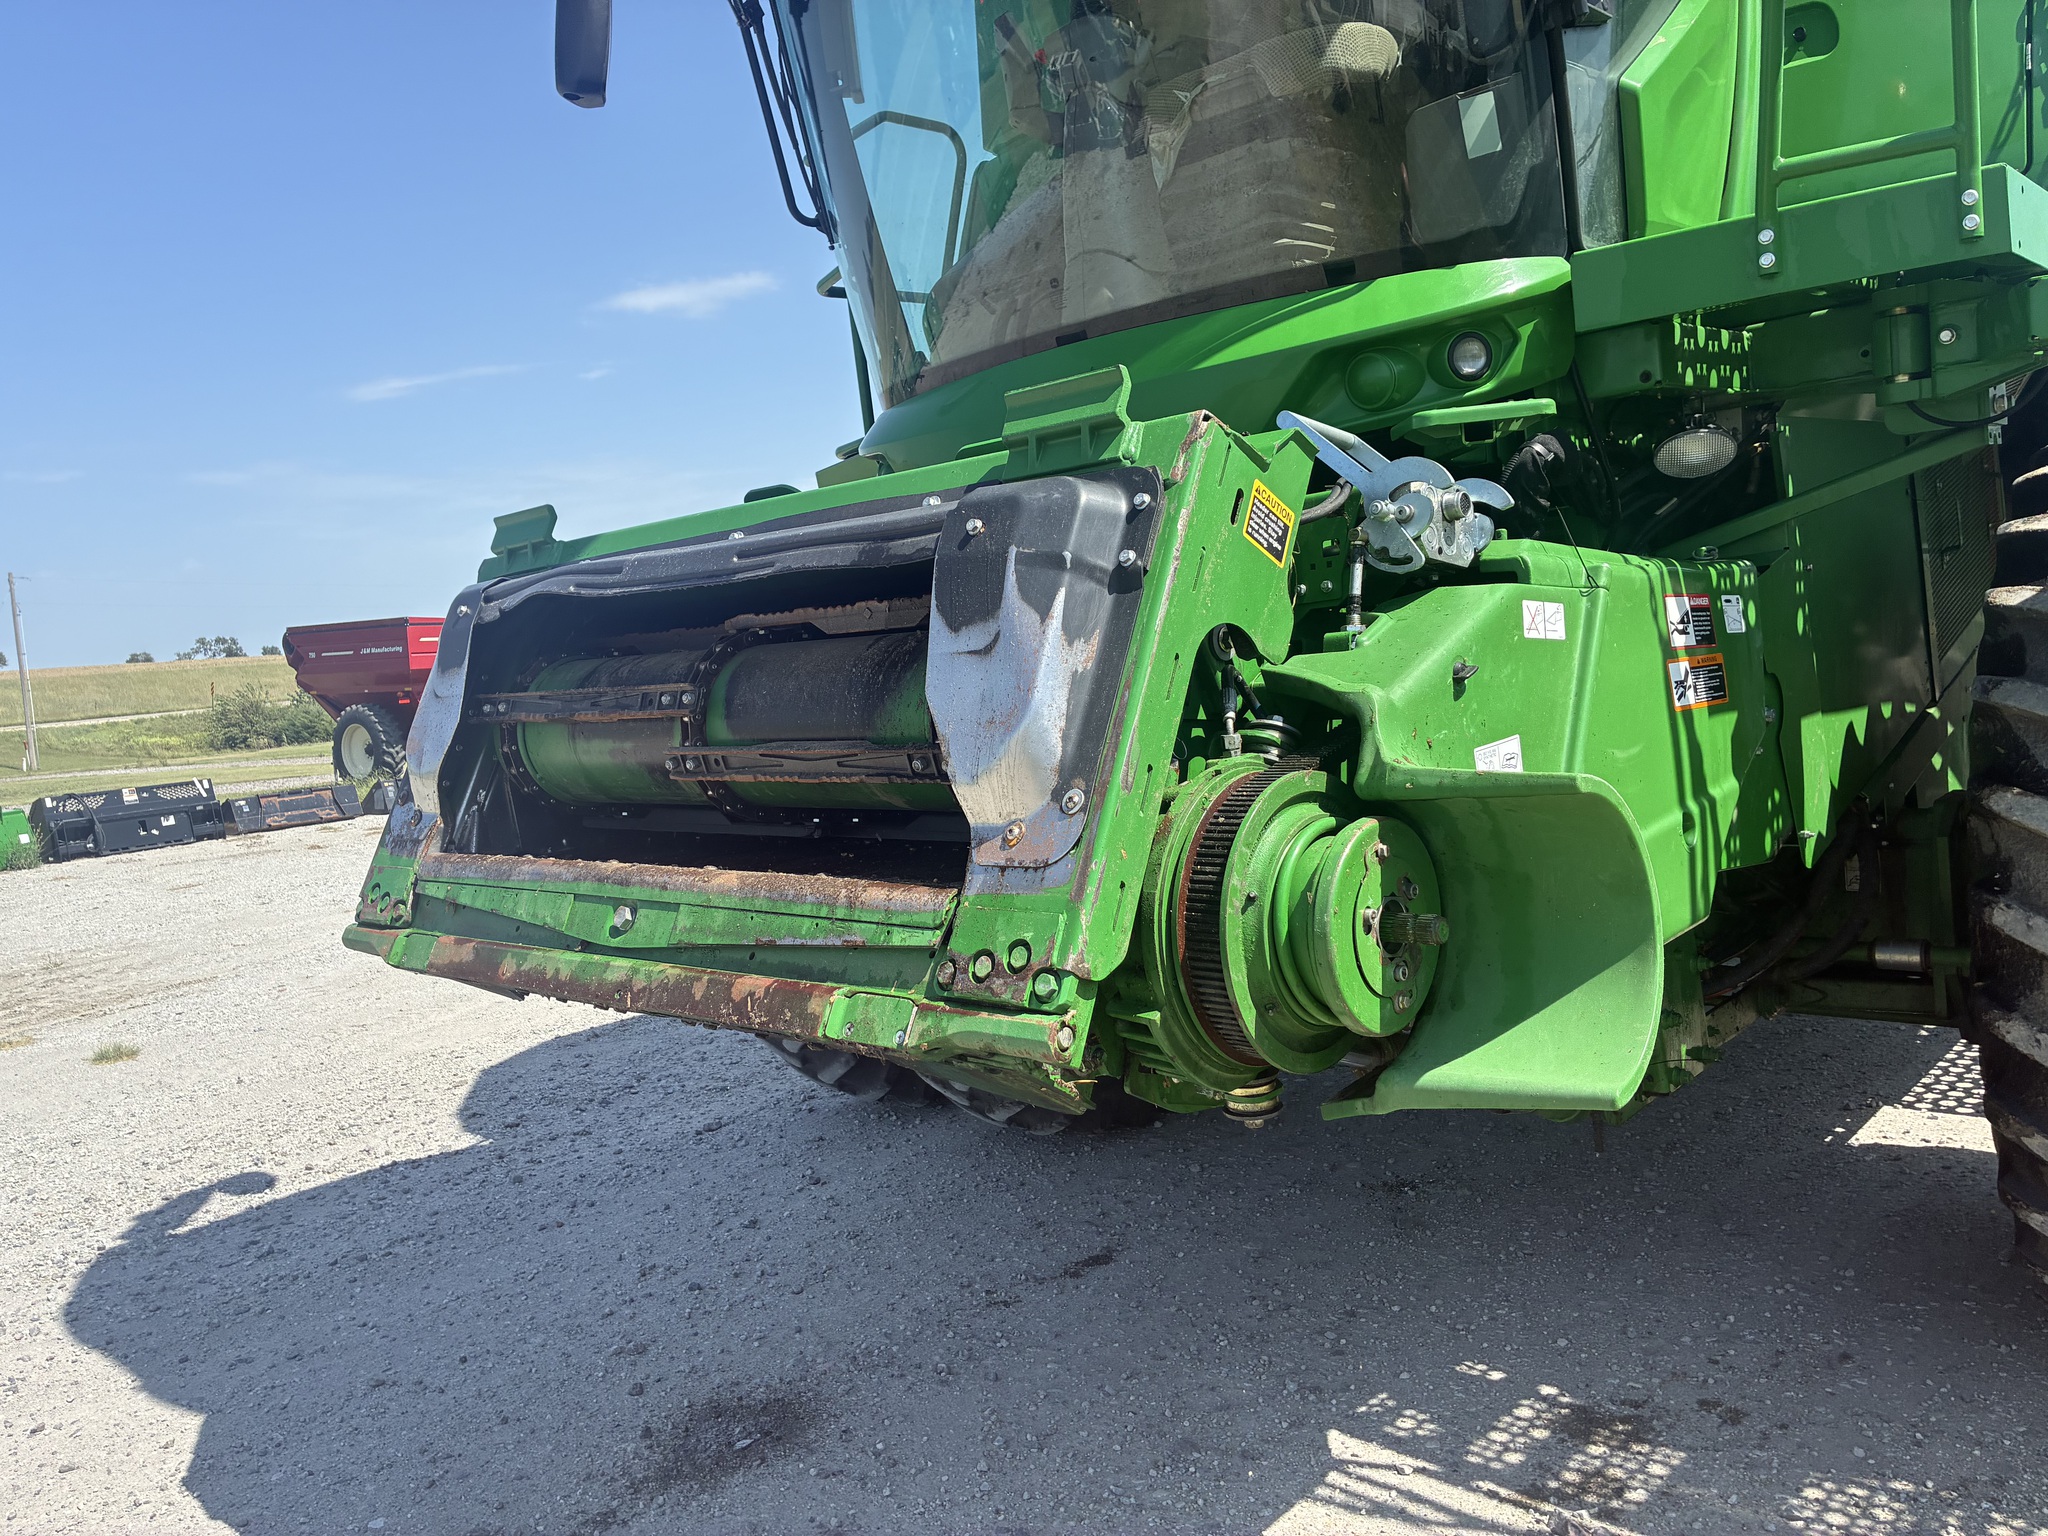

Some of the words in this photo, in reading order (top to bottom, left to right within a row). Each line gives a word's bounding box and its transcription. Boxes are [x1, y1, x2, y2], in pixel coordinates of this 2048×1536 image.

[1254, 497, 1270, 514] Header
[1269, 512, 1278, 523] can
[1261, 489, 1293, 524] CAUTION
[1252, 505, 1265, 519] Avoid
[1265, 516, 1283, 536] crushing
[1258, 528, 1270, 540] when
[1269, 537, 1282, 551] engine
[1267, 526, 1278, 540] Stay
[371, 645, 403, 655] Manufacturing
